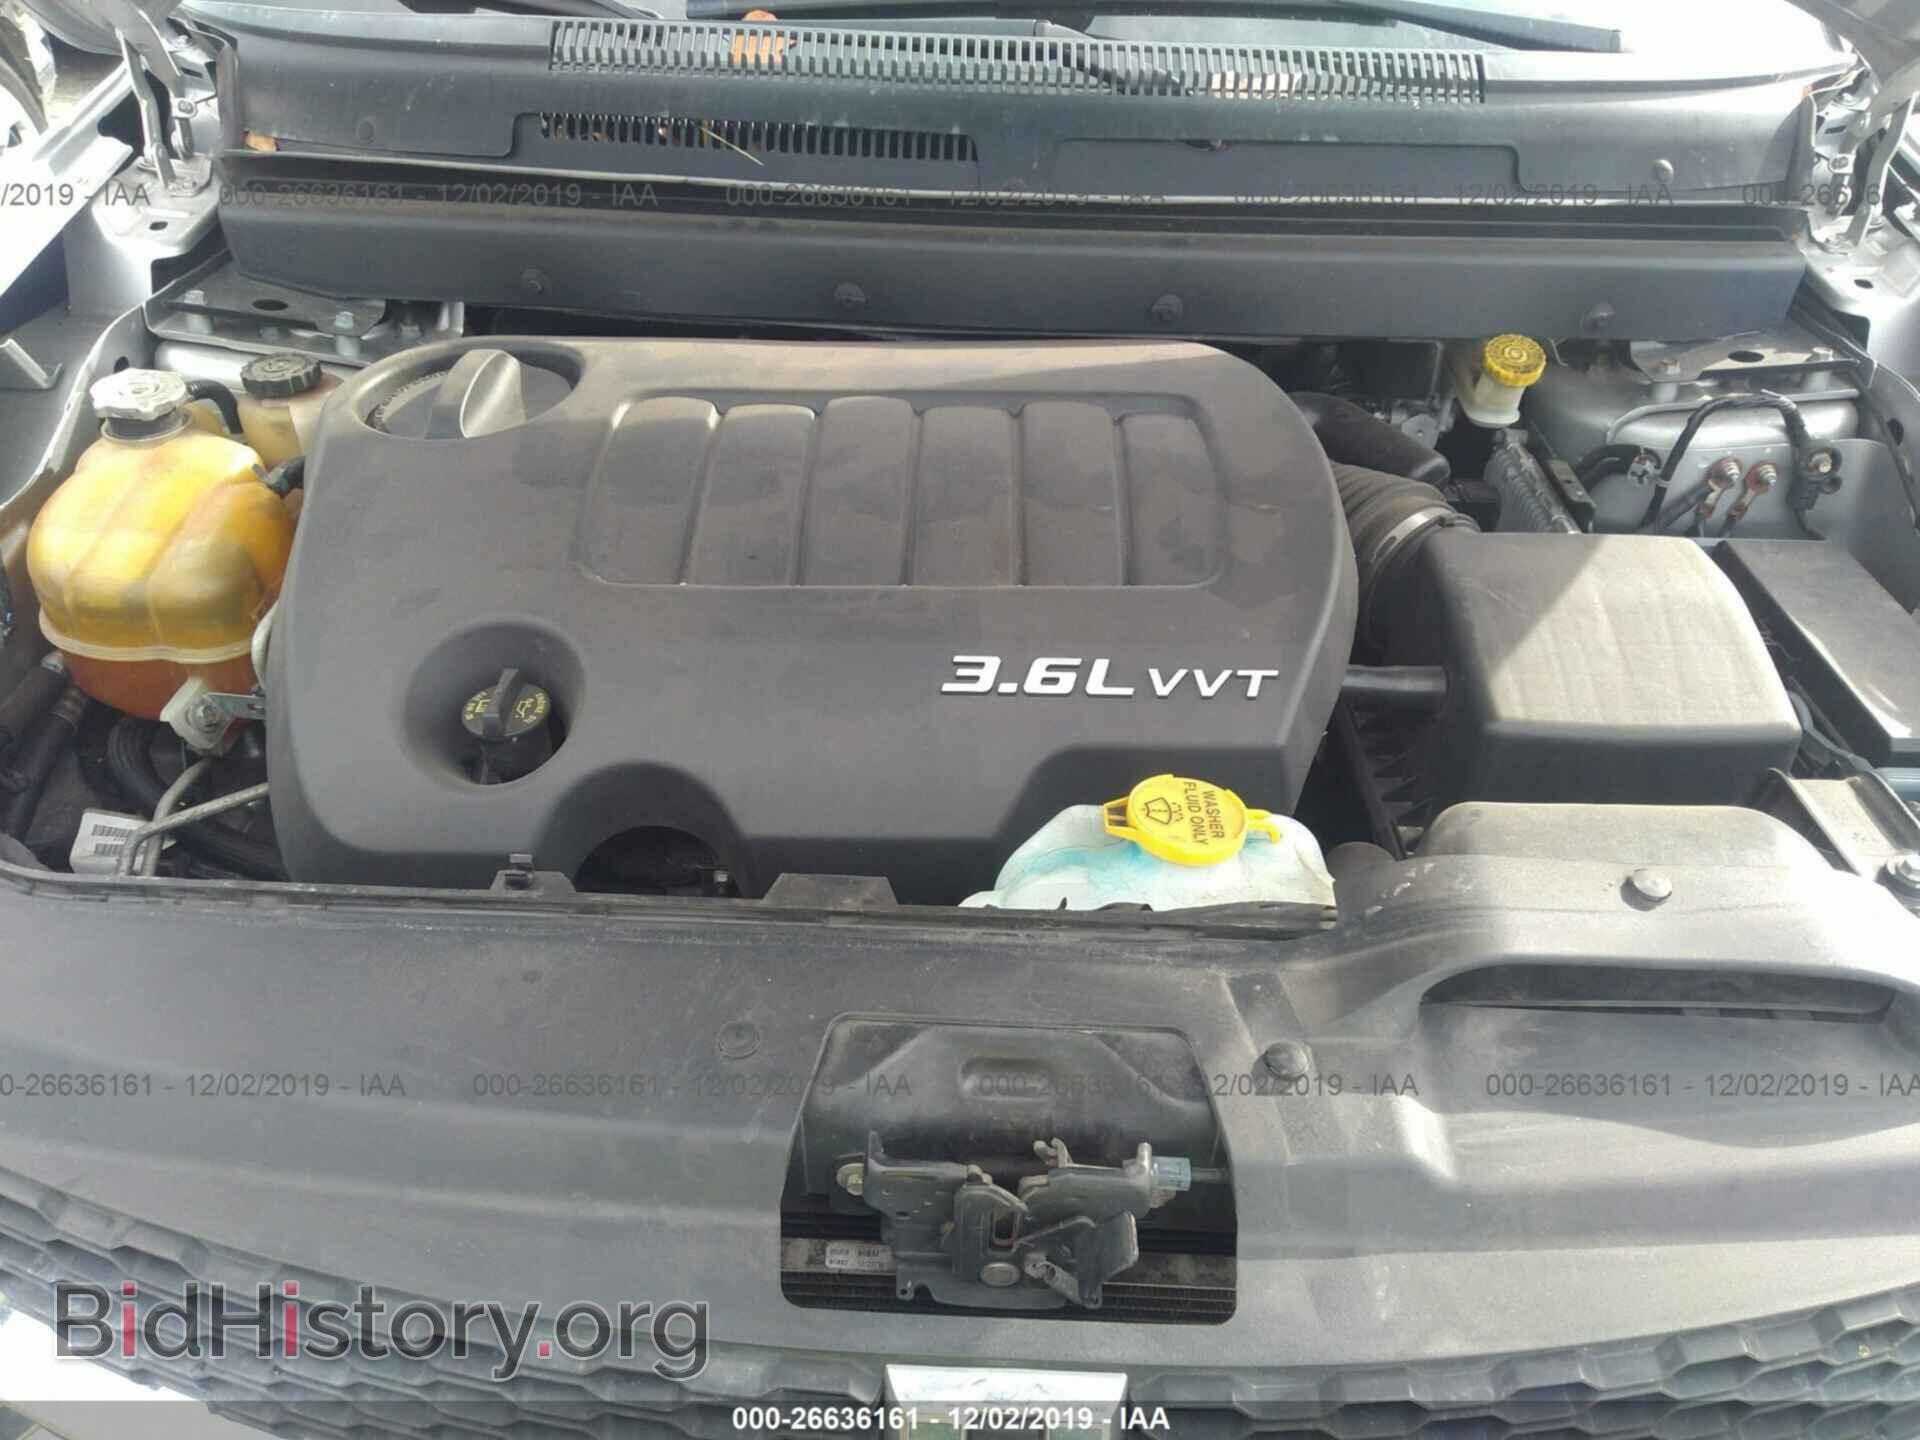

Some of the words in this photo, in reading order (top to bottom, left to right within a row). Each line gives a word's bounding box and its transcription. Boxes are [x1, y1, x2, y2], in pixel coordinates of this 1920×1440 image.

[940, 654, 1135, 698] 3.6L
[1148, 668, 1280, 700] VVT
[1183, 781, 1201, 814] FLUID
[1202, 790, 1225, 840] WASHER
[1189, 815, 1209, 846] ONLY
